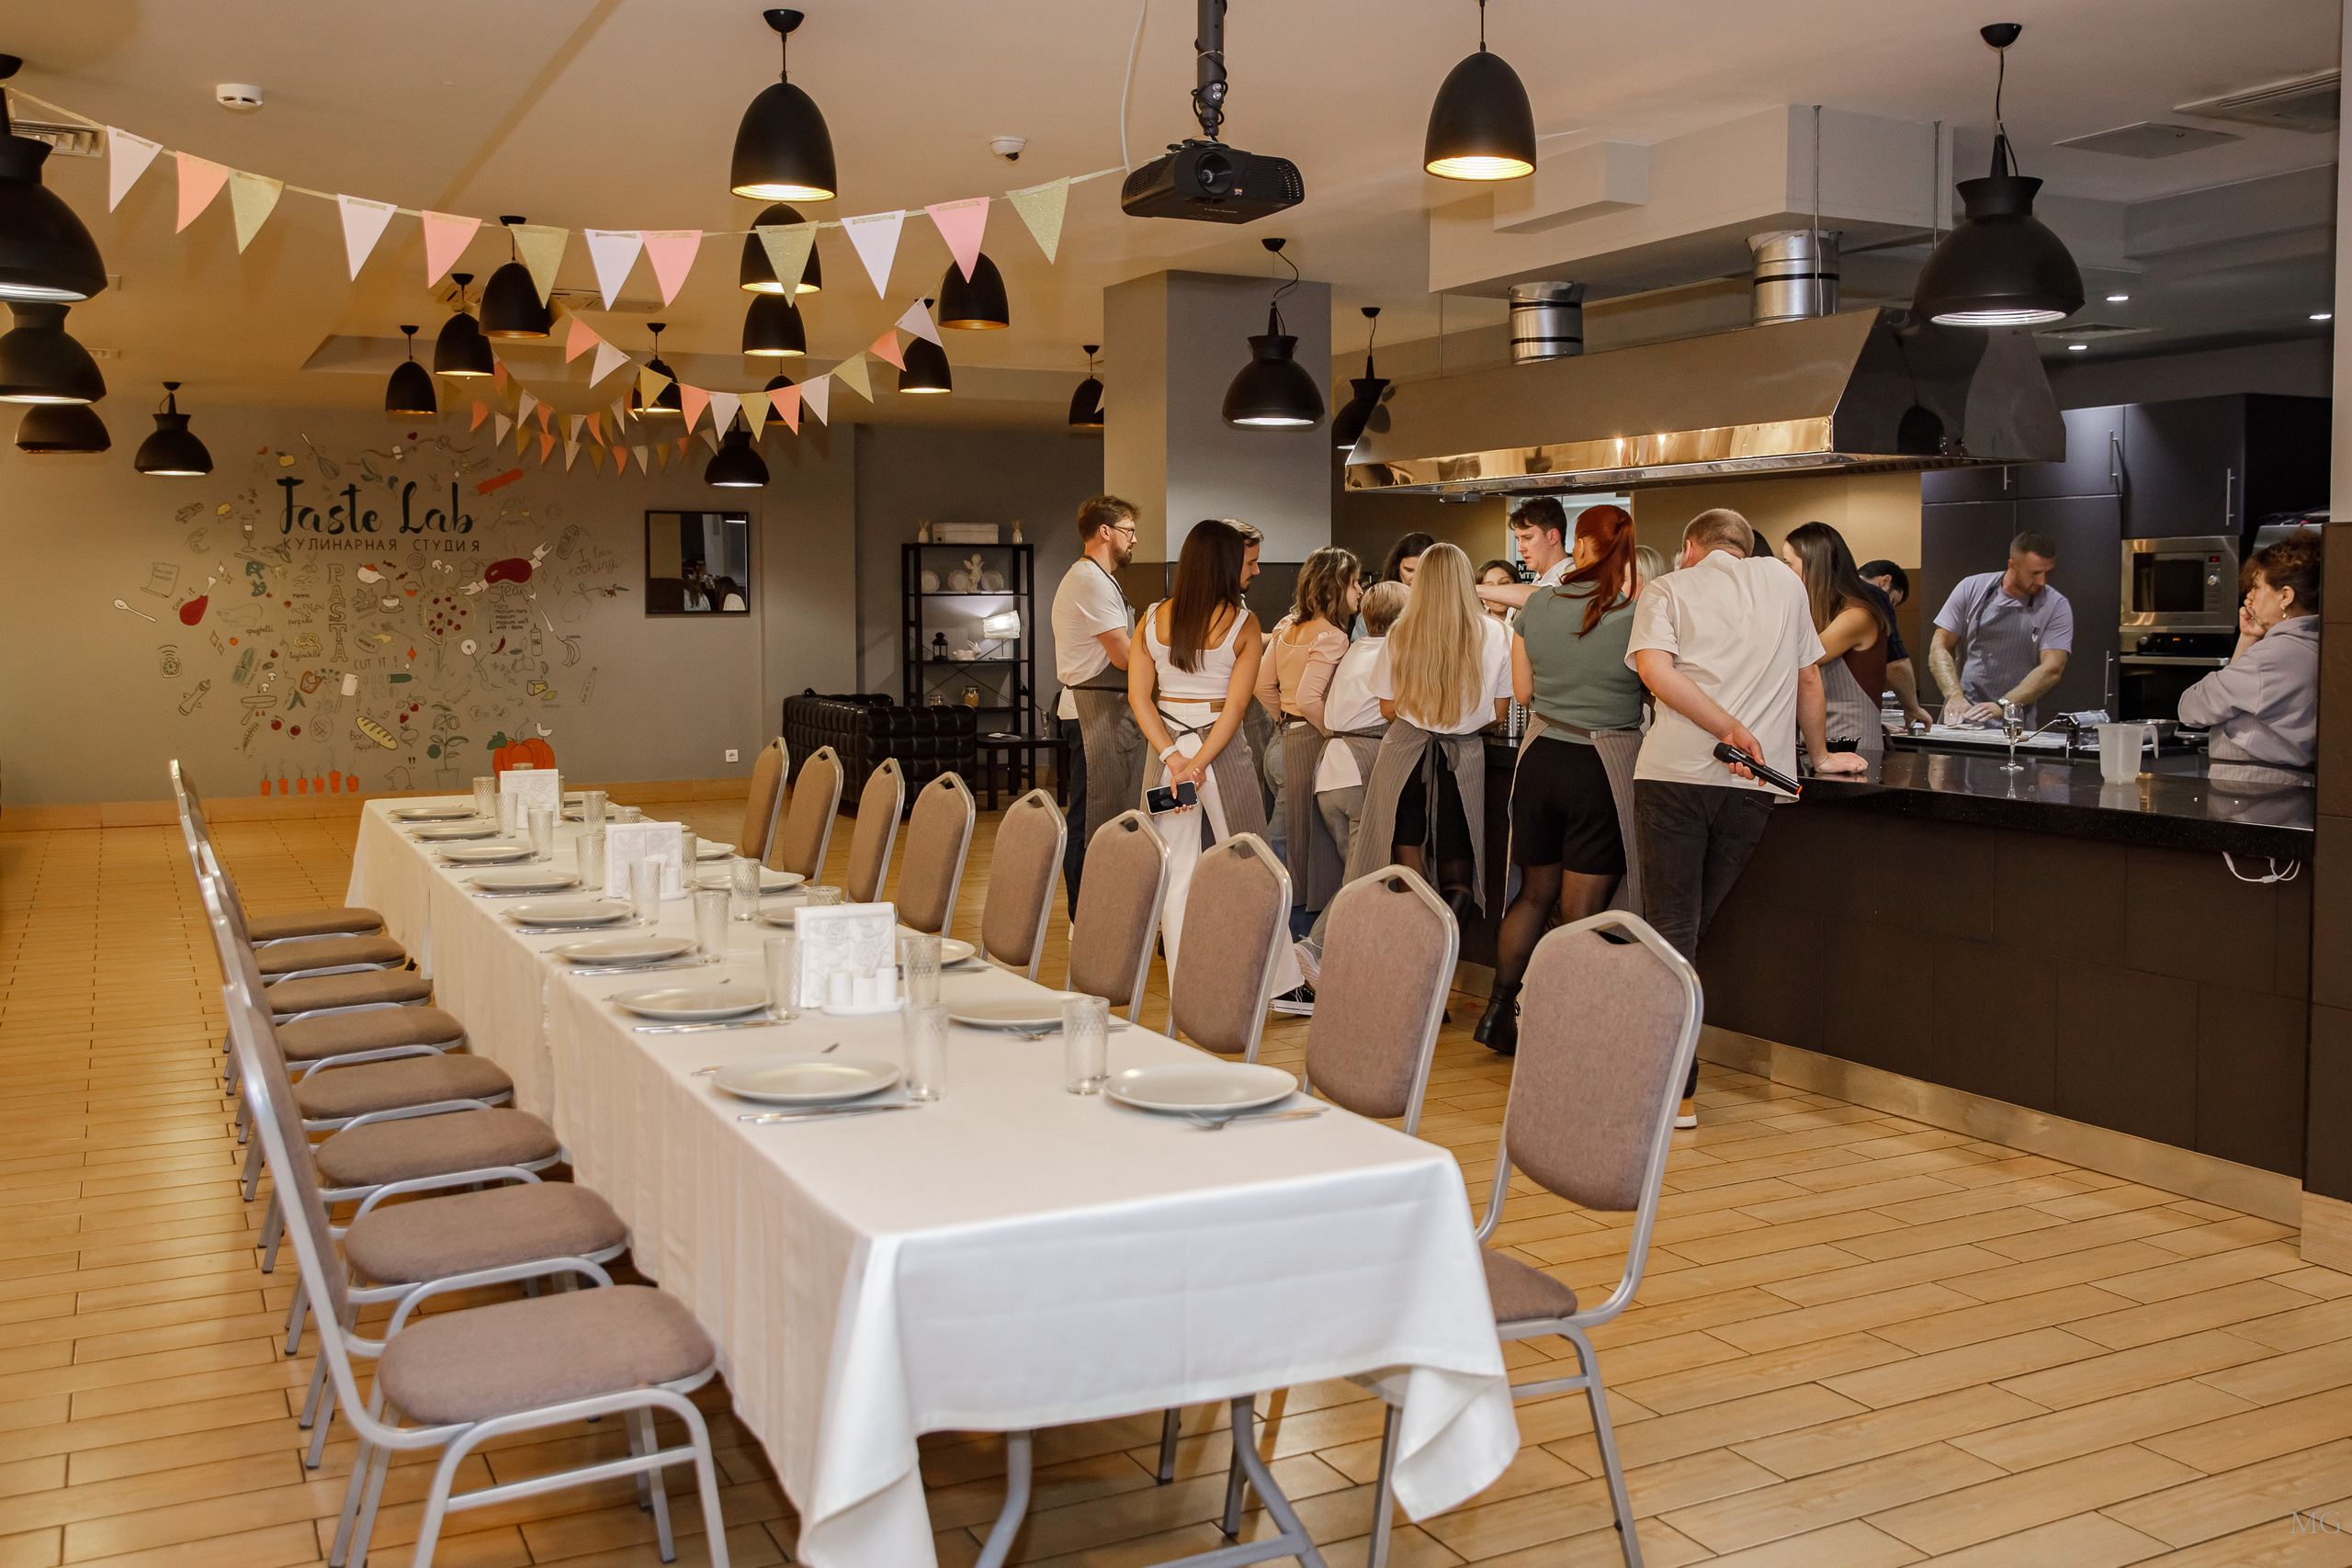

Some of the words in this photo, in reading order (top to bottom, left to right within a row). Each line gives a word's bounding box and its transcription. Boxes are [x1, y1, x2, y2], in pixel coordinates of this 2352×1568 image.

[276, 476, 382, 535] Taste
[399, 481, 480, 535] Lab
[283, 538, 397, 550] КУЛИНАРНАЯ
[413, 538, 480, 552] СТУДИЯ
[327, 563, 348, 662] PASTA
[354, 659, 371, 670] CUT
[349, 730, 366, 740] Bon
